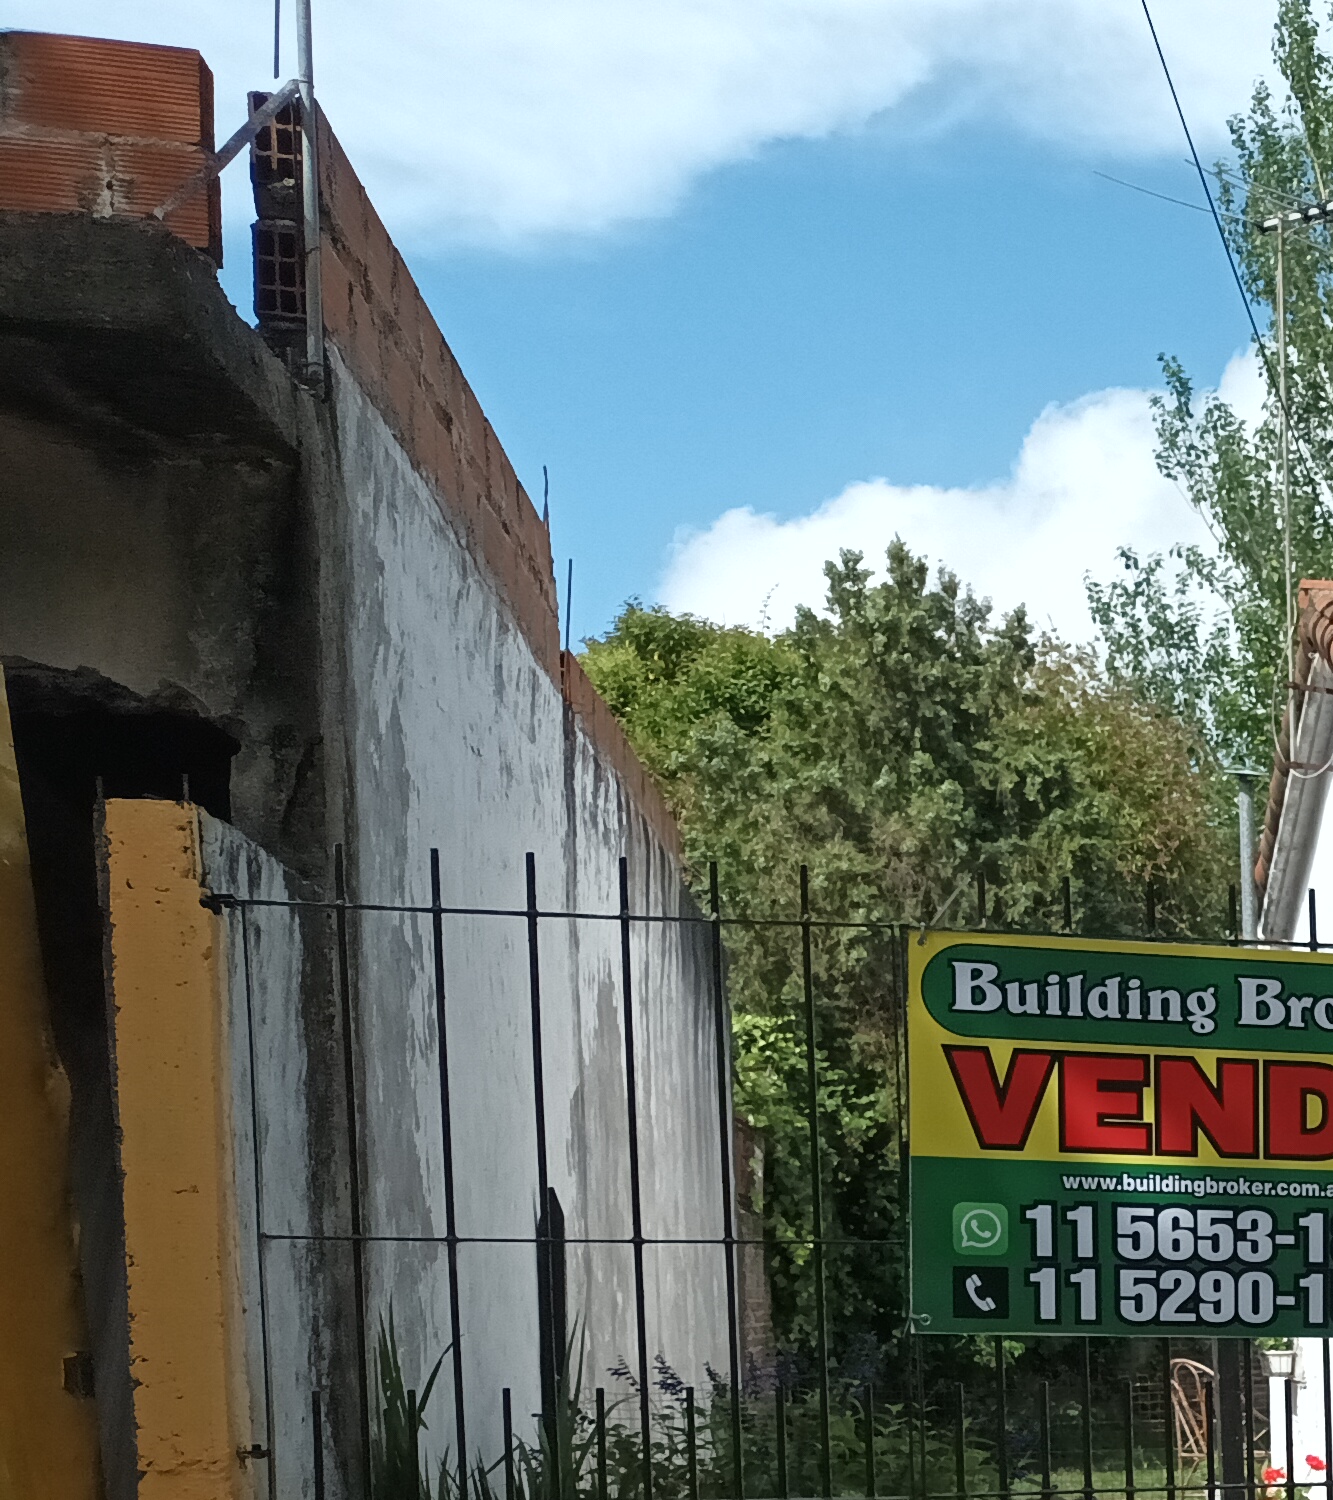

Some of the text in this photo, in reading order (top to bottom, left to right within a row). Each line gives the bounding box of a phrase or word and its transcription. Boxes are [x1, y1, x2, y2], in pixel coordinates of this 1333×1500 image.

[952, 961, 1216, 1033] Building
[1025, 1204, 1094, 1259] 11
[1029, 1267, 1097, 1321] 11
